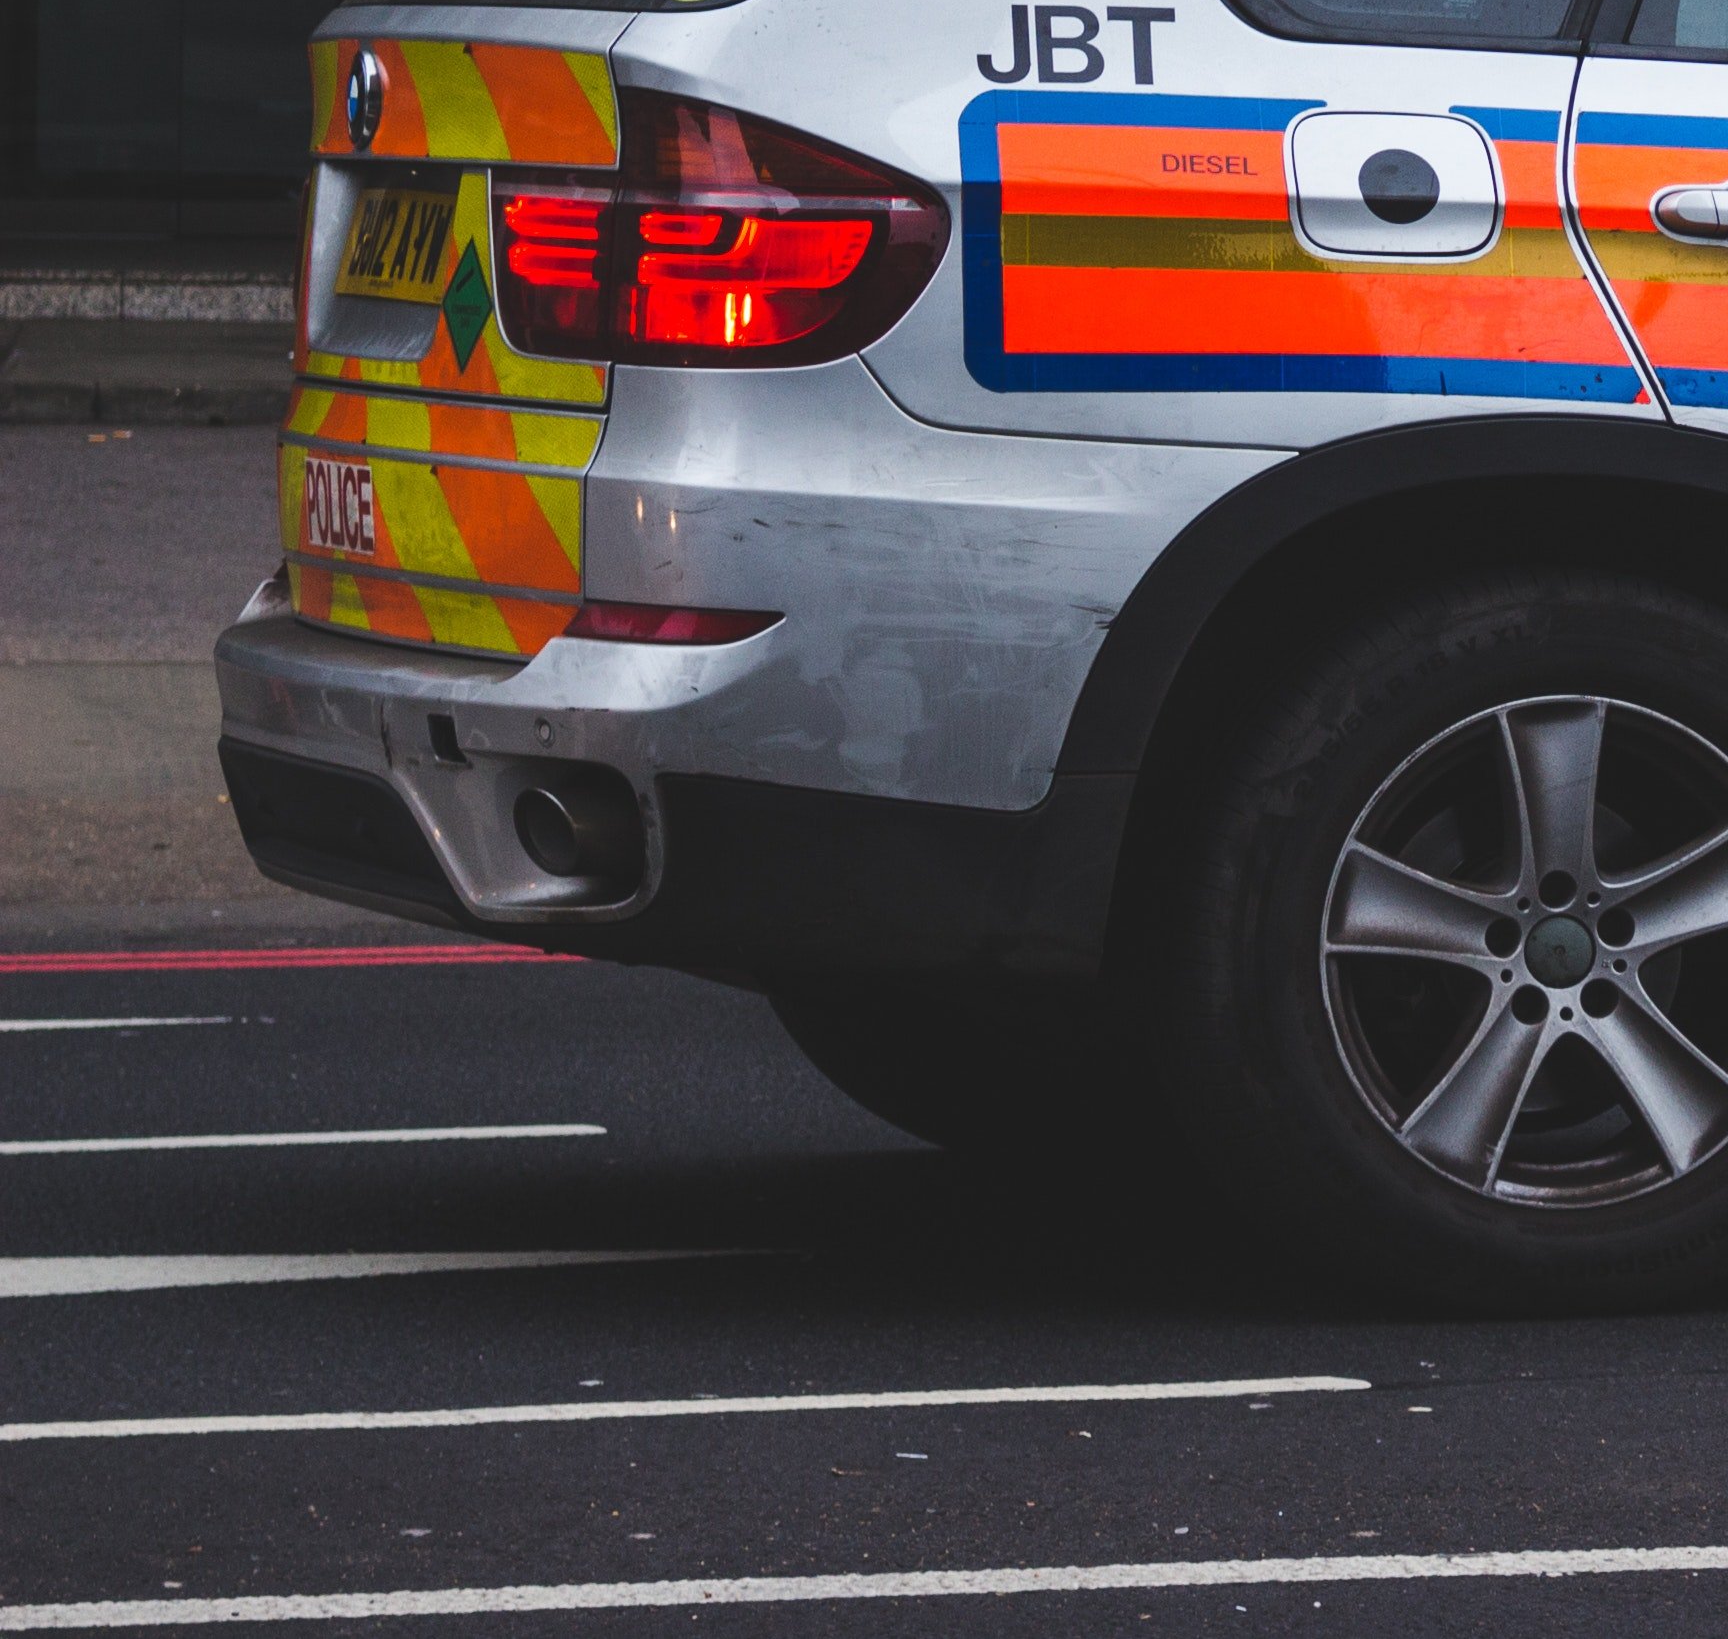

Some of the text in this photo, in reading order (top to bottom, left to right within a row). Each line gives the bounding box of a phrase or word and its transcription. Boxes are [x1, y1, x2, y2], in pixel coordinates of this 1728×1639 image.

[976, 4, 1176, 85] JBT
[1160, 152, 1258, 177] DIESEL
[305, 456, 374, 553] POLICE
